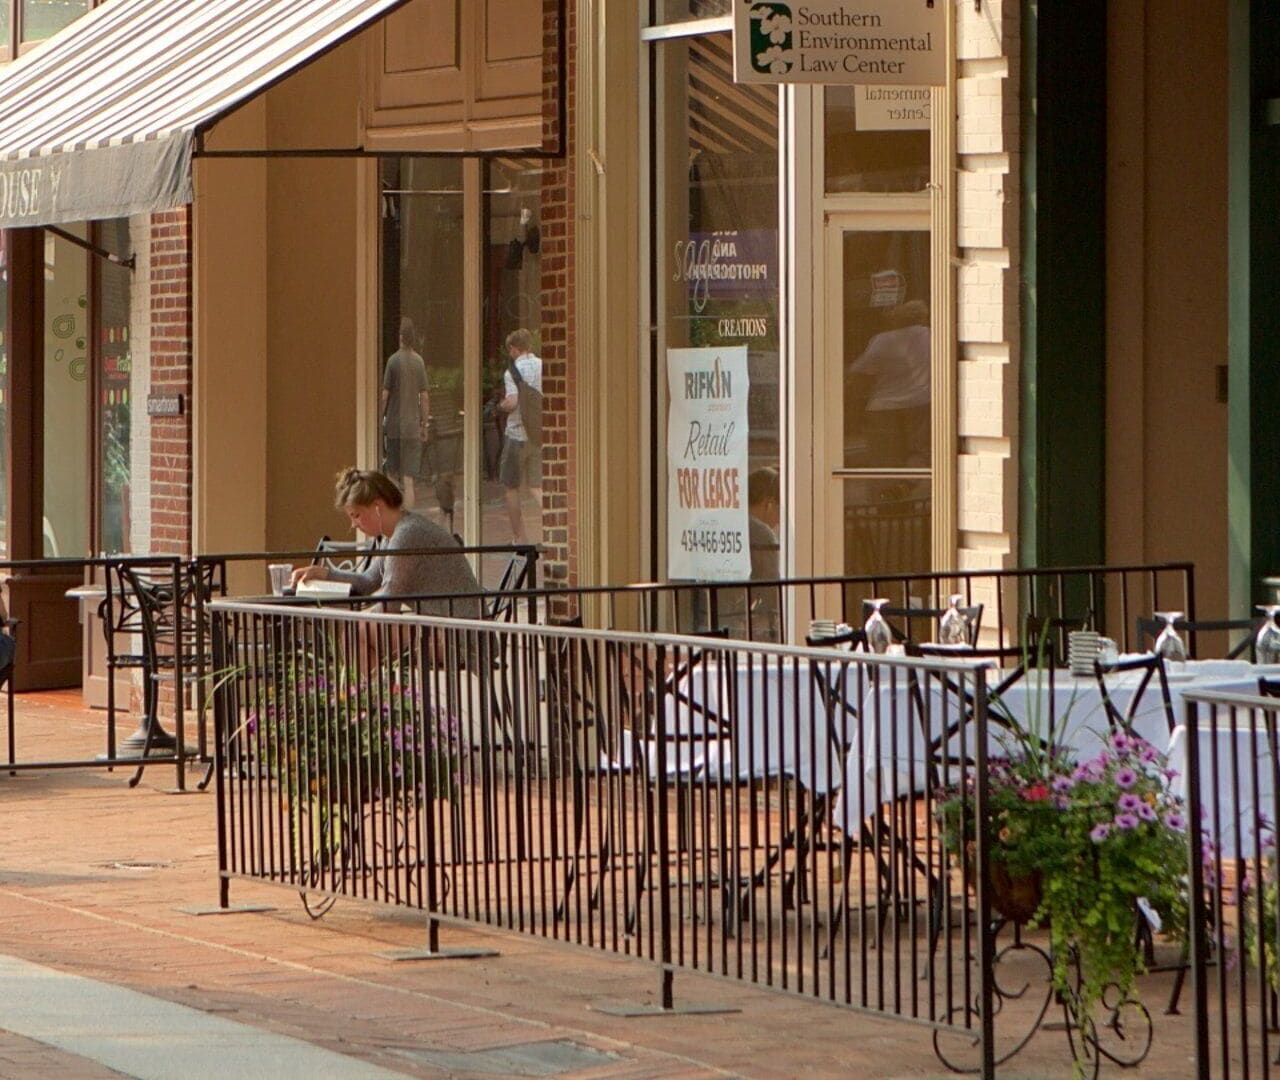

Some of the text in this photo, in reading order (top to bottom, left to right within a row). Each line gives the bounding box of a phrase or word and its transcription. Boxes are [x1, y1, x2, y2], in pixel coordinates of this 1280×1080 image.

[798, 7, 881, 27] Southern
[799, 31, 932, 51] Environmental
[800, 54, 905, 74] Law Center
[718, 318, 767, 336] CREATIONS
[684, 356, 732, 400] RIFKIN
[683, 420, 736, 461] Retail
[677, 467, 740, 509] FOR LEASE
